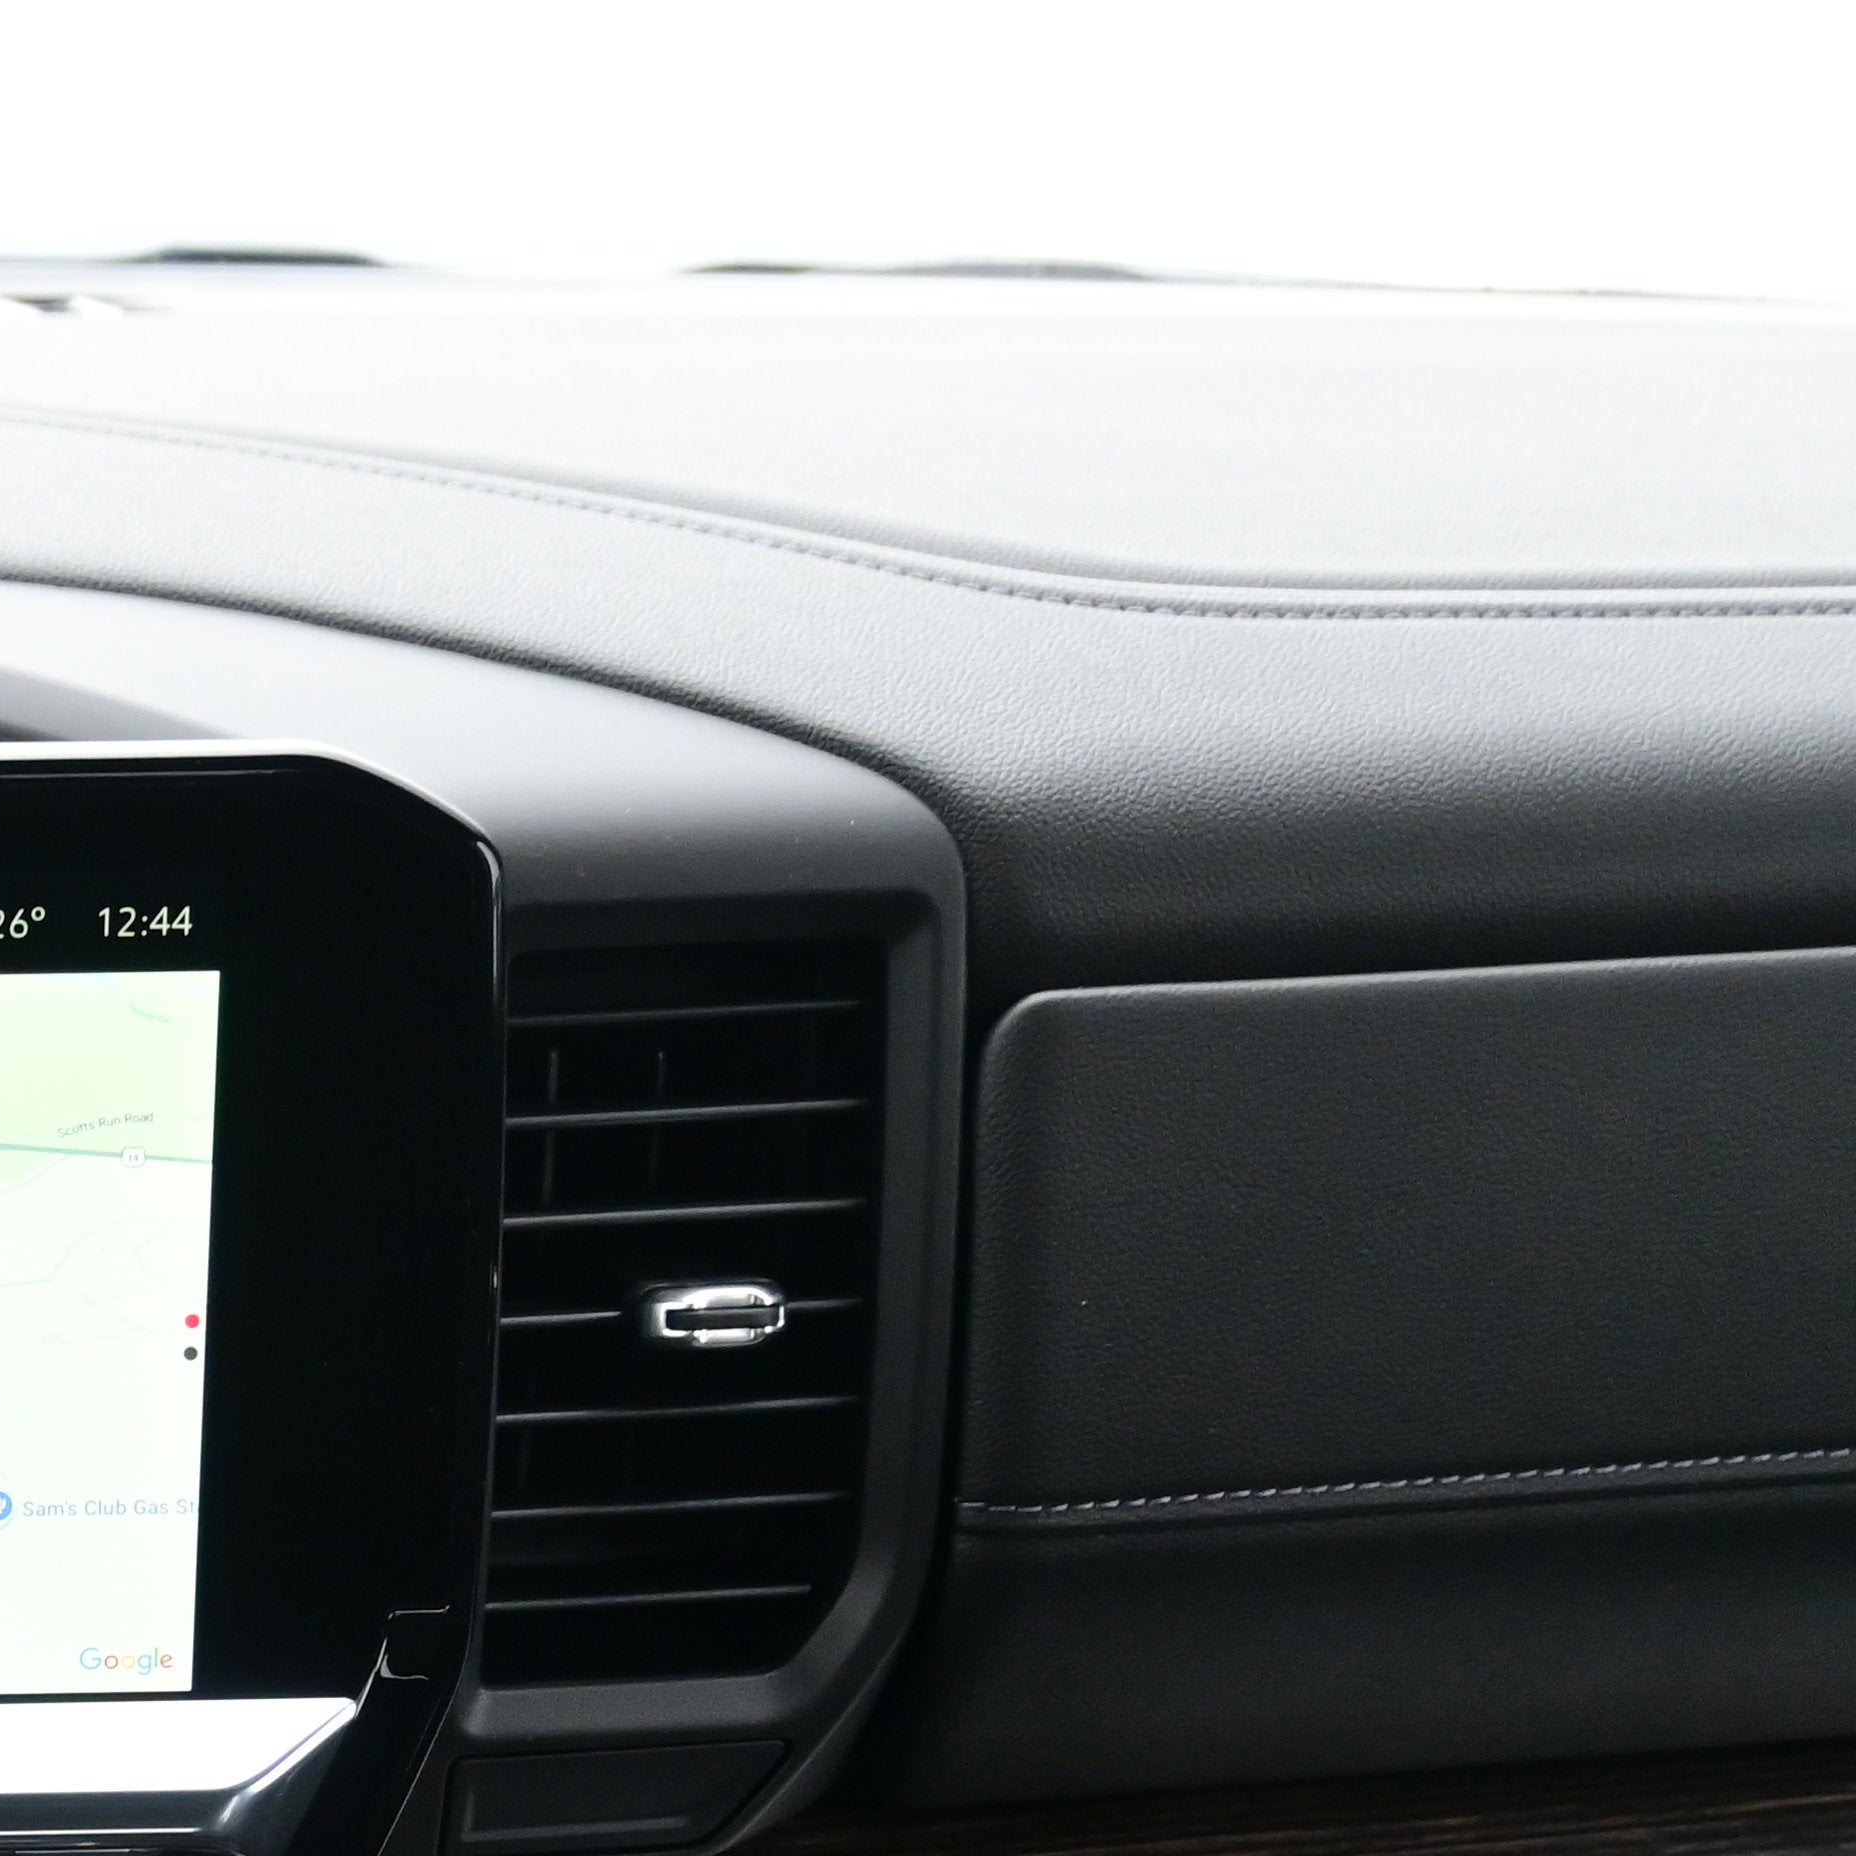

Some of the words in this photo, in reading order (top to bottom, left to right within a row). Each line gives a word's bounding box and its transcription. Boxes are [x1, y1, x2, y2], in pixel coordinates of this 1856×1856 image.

[98, 905, 193, 938] 12:44
[57, 1122, 96, 1138] Scotts
[98, 1117, 121, 1128] Run
[124, 1113, 154, 1123] Road
[23, 1501, 77, 1517] Sam's
[84, 1499, 127, 1516] Club
[133, 1499, 169, 1515] Gas
[176, 1498, 195, 1514] St
[79, 1647, 173, 1676] Google
